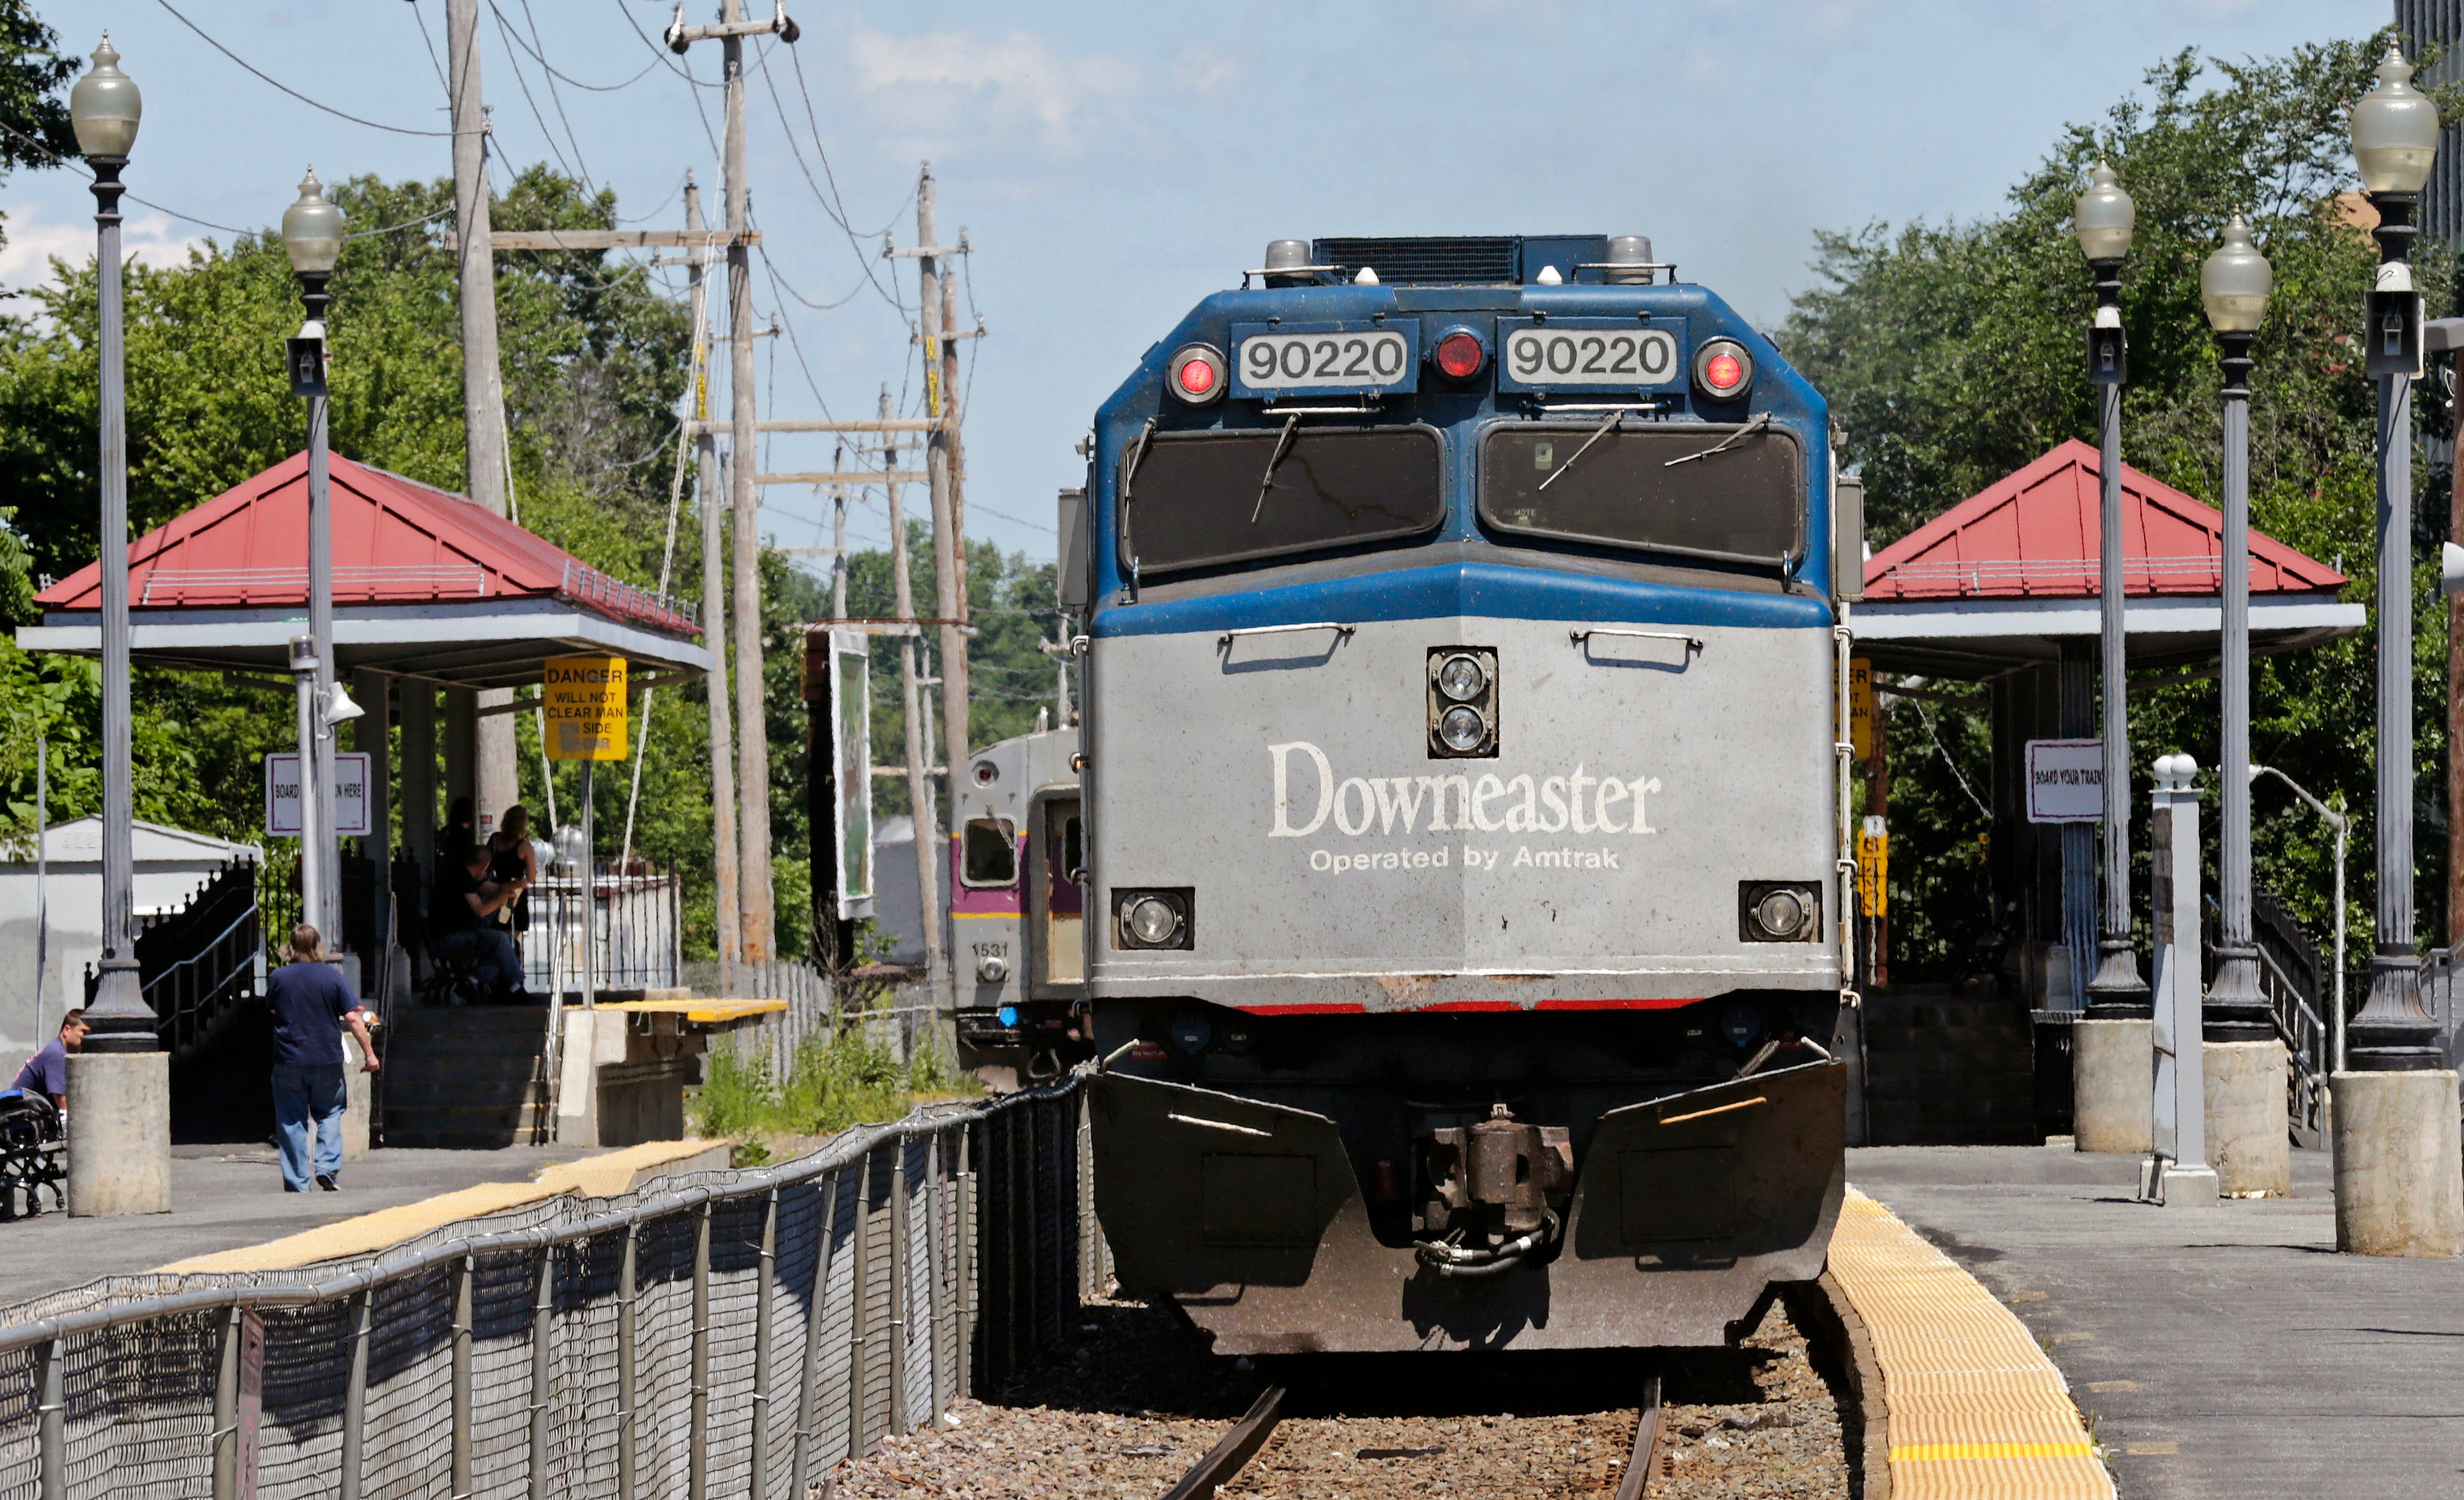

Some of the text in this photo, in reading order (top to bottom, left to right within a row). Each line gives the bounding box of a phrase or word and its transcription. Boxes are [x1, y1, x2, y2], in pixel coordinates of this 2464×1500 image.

[1248, 338, 1403, 379] 90220
[1514, 336, 1669, 375] 90220
[548, 669, 623, 683] DANGER
[554, 692, 617, 703] WILL NOT
[548, 707, 623, 718] CLEAR MAN
[583, 722, 612, 734] SIDE
[2035, 769, 2102, 785] BOARD YOUR TRAIN
[275, 783, 299, 799] BOARD
[343, 783, 362, 798] HERE
[1267, 741, 1661, 837] Downeaster
[1310, 845, 1620, 874] Operated by Amtrak
[972, 941, 1009, 956] 1531
